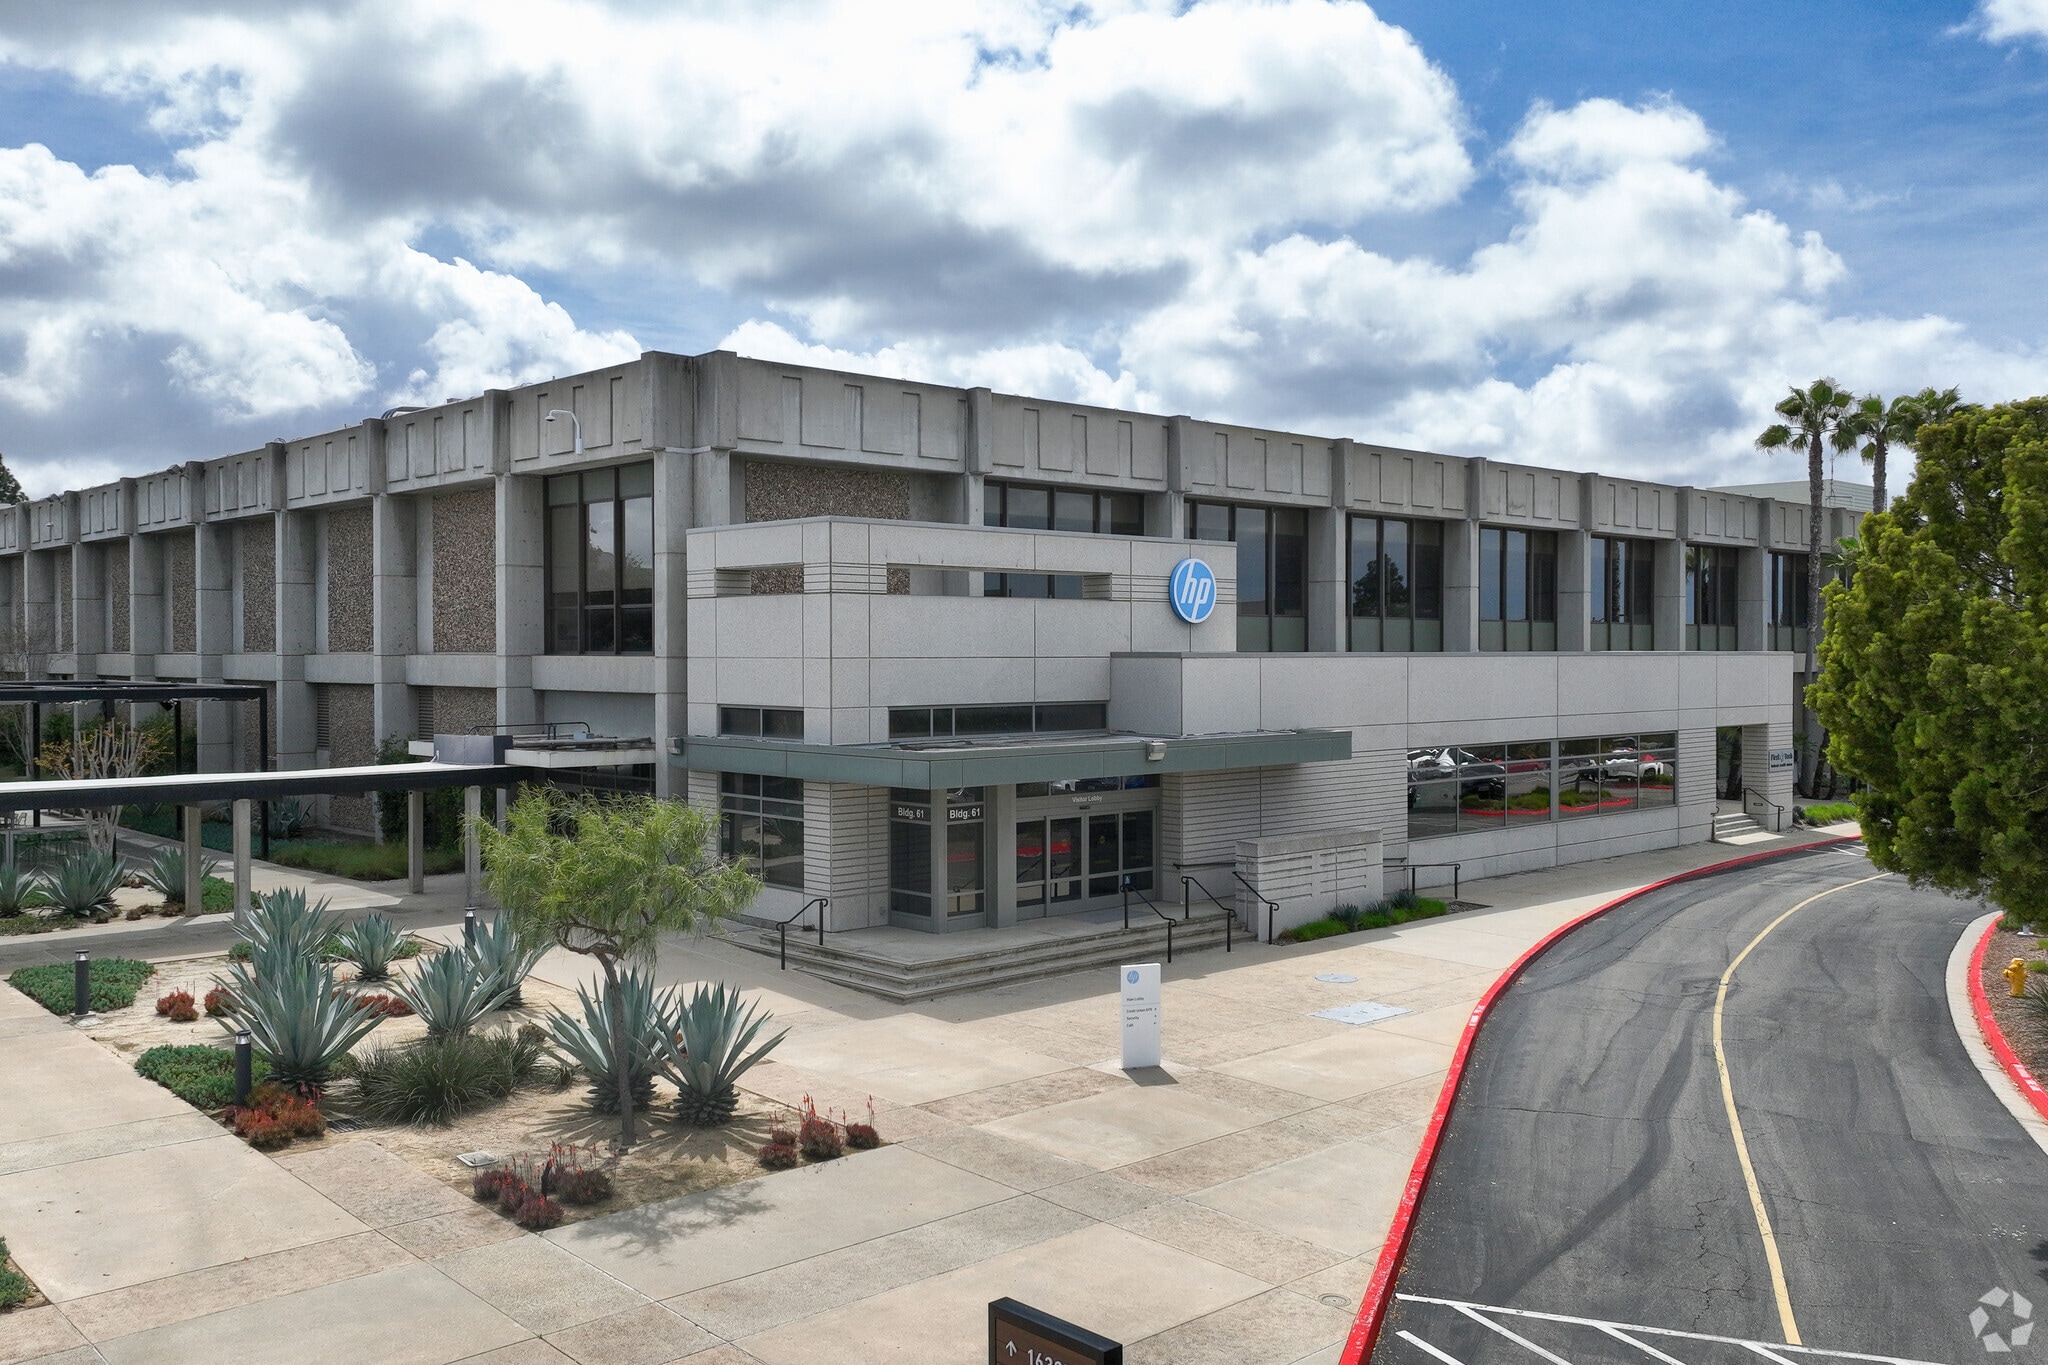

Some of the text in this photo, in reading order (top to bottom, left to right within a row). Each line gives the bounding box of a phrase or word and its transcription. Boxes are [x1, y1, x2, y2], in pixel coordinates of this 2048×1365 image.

[1179, 559, 1213, 622] hp
[1088, 795, 1103, 803] Lobby
[898, 807, 924, 819] Bldg. 61
[949, 807, 981, 820] Bldg. 61
